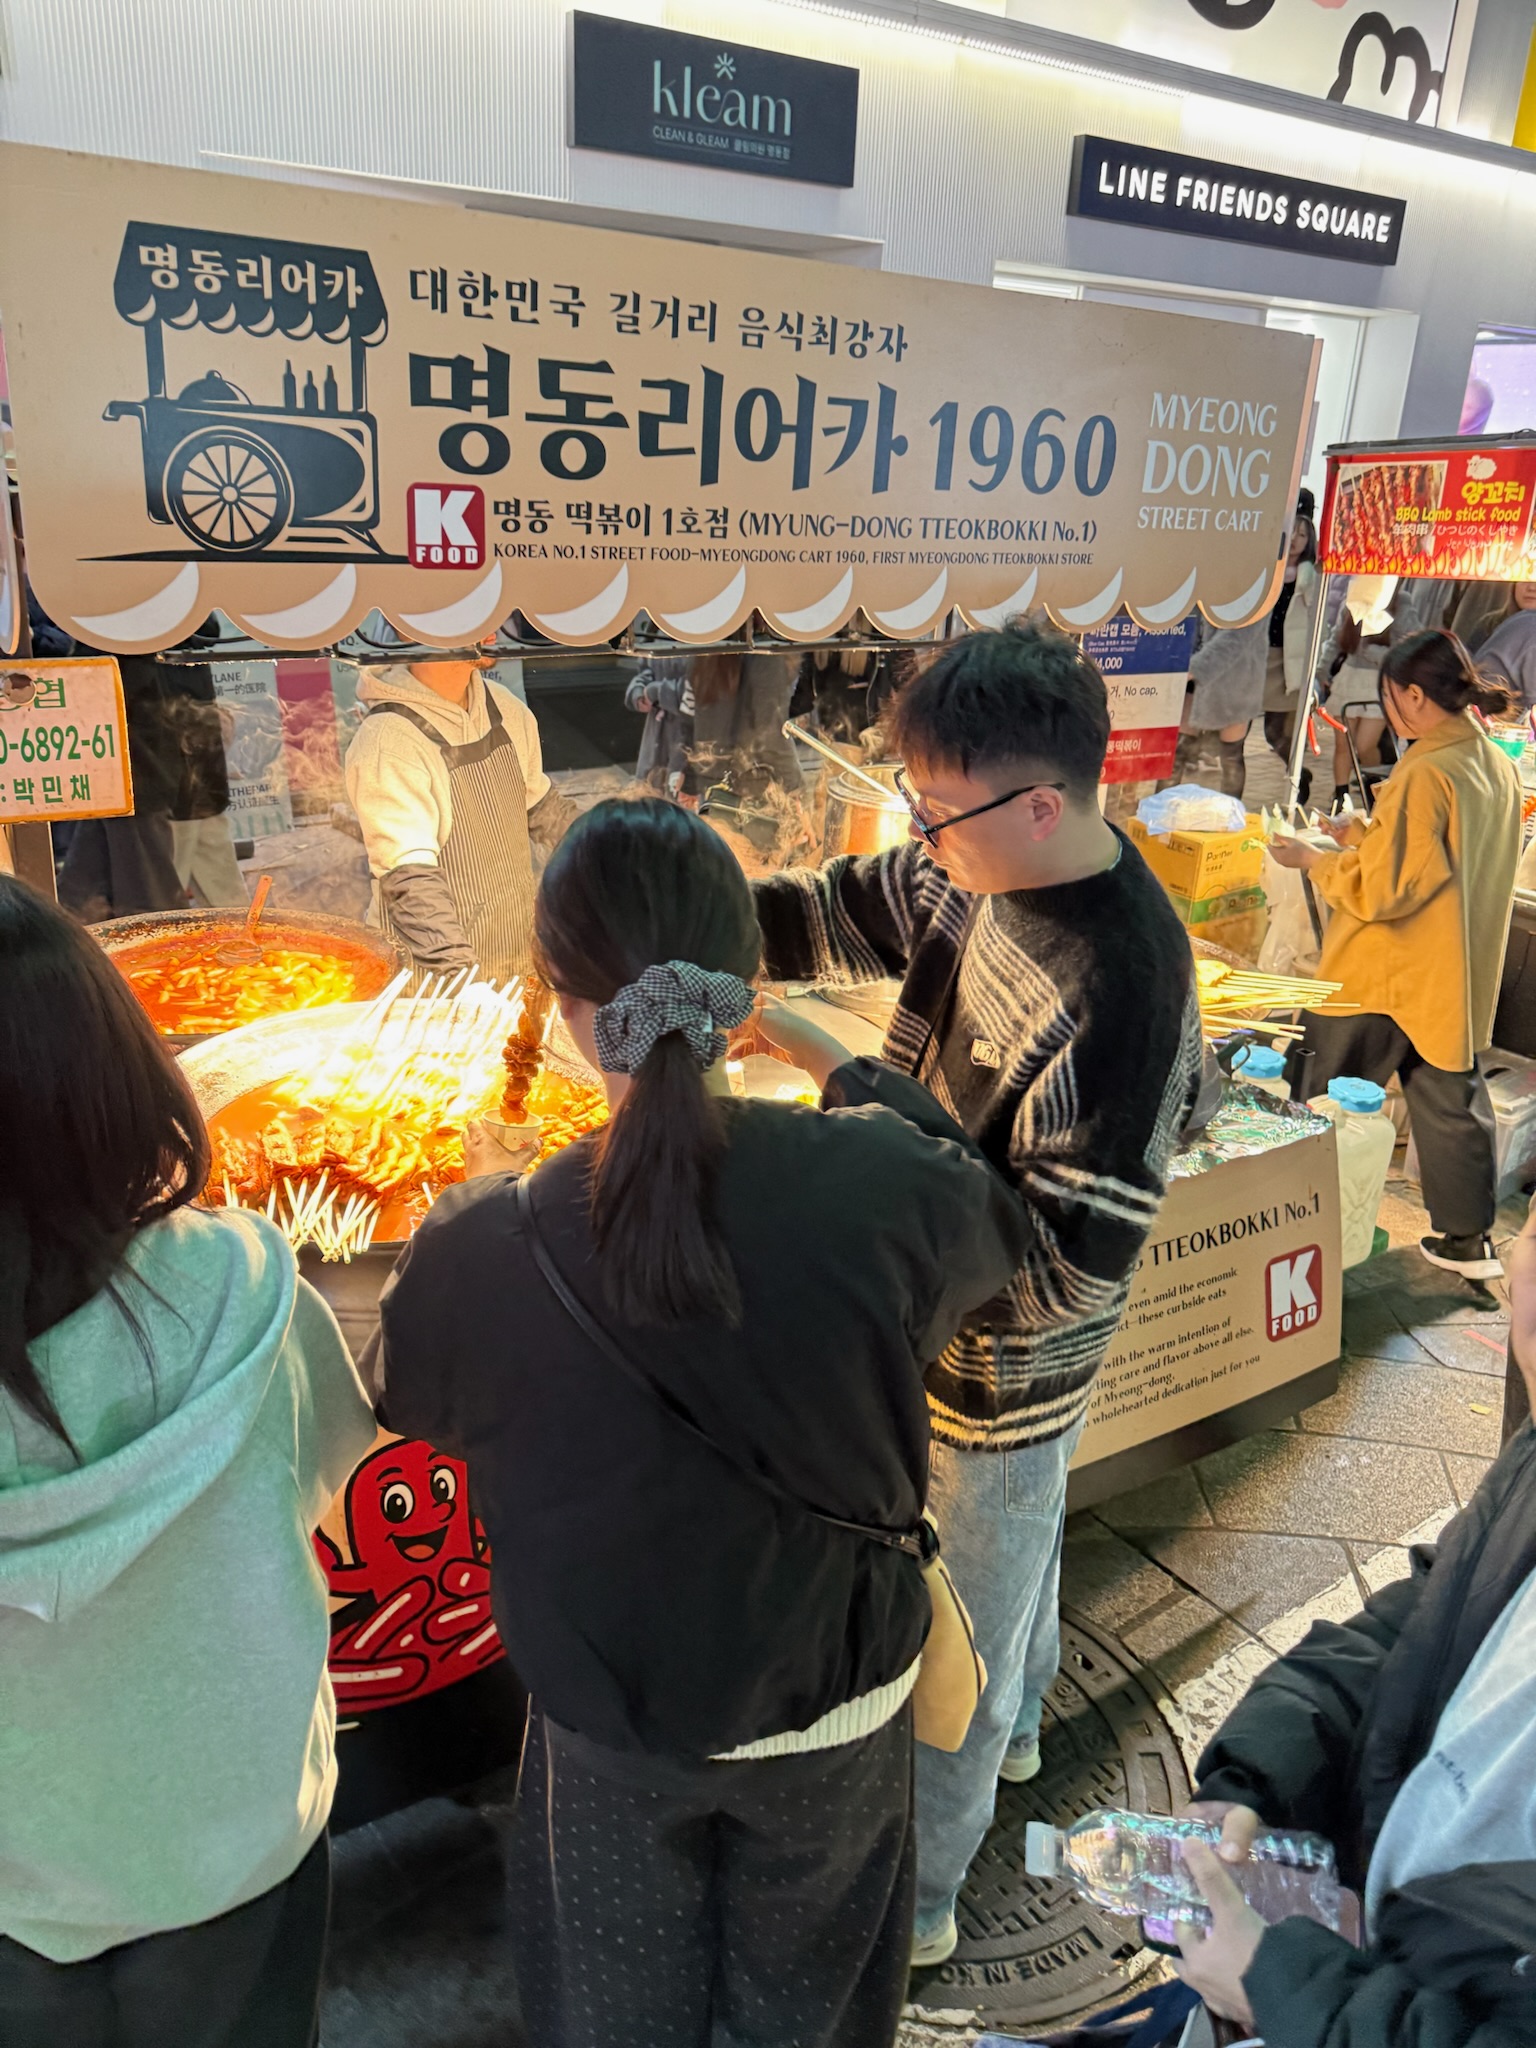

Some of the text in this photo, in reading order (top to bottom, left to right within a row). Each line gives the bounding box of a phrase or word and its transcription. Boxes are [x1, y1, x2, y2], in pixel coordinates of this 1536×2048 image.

[652, 125, 686, 143] CLEAN
[686, 131, 696, 144] &
[695, 132, 730, 149] GLEAM
[1099, 161, 1391, 243] LINE FRIENDS SQUARE
[138, 242, 365, 309] 명동리어카
[408, 266, 909, 363] 대한민국 길거리 음식최강자
[408, 342, 1118, 498] 명동리어카 1960
[1149, 392, 1278, 438] MYEONG
[1141, 440, 1272, 499] DONG
[1395, 506, 1522, 522] BBQ Lamb stick food
[1461, 481, 1526, 506] 양꼬치
[414, 488, 478, 547] K
[493, 497, 1098, 545] 명동 떡볶이 1호점 (MYUNG-DONG TTEOKBOKKI No.1)
[1136, 506, 1264, 533] STREET CART
[415, 546, 479, 565] FOOD
[493, 543, 1095, 566] KOREA NO.1 STREET FOOD-MYEONGDONG CART 1960, FIRST MYEONGDONG TTEOKBOKKI STORE
[1124, 685, 1137, 697] No
[1149, 1192, 1321, 1267] TTEOKBOKKI No.1
[1128, 1267, 1238, 1312] even amid the economic
[1166, 1295, 1206, 1316] curbside
[1208, 1287, 1227, 1302] eats
[1270, 1249, 1318, 1319] K
[1271, 1303, 1318, 1337] FOOD
[1094, 1375, 1117, 1391] ting
[1119, 1368, 1141, 1382] care
[1143, 1358, 1161, 1374] and
[1163, 1350, 1190, 1367] flavor
[1193, 1339, 1220, 1356] above
[1221, 1331, 1233, 1345] all
[1103, 1315, 1232, 1371] with the warm intention of
[1090, 1394, 1102, 1409] of
[1092, 1353, 1261, 1424] wholehearted dedication just for you
[982, 1962, 1011, 1987] IN
[1015, 1937, 1091, 1981] MADE
